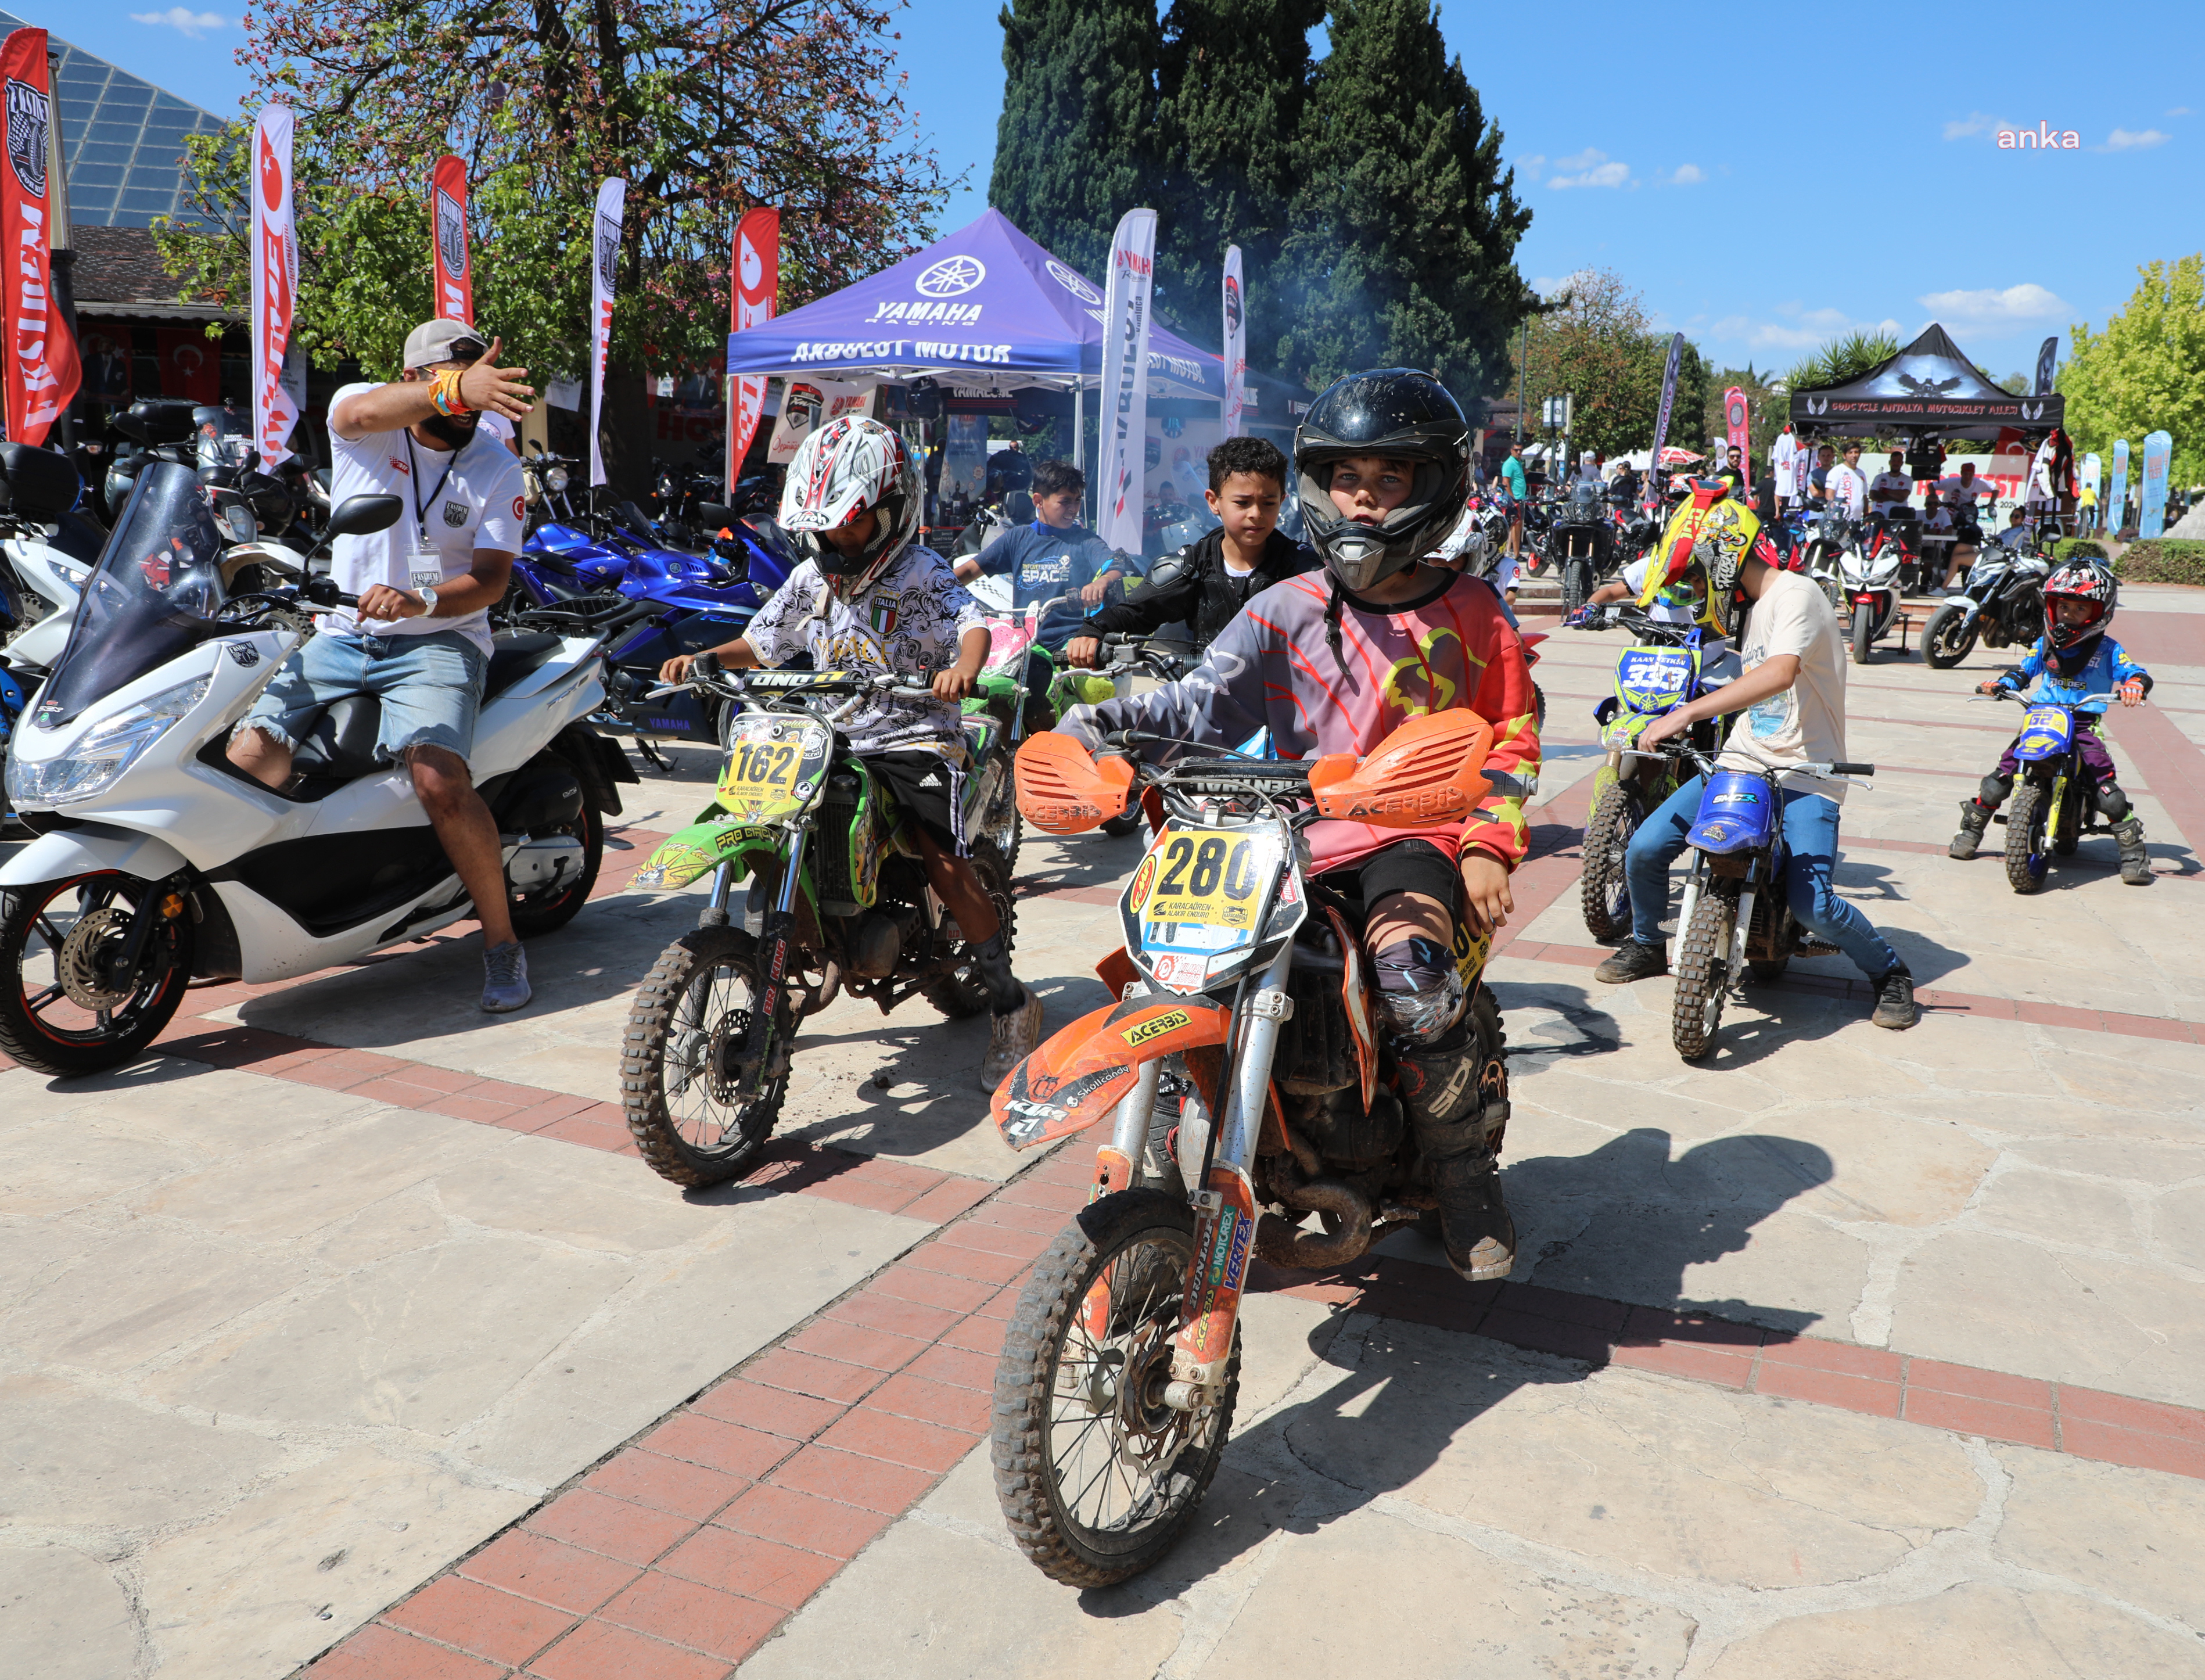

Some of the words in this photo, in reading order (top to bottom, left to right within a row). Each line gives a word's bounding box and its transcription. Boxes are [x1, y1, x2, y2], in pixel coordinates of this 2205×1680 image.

[874, 301, 983, 321] YAMAHA
[865, 318, 976, 326] RACING
[915, 342, 1012, 363] MOTOR
[1832, 402, 1879, 412] GODCYCLE
[1881, 403, 1924, 413] ANTALYA
[447, 502, 468, 515] EKSTREM
[787, 511, 828, 523] Airoh
[413, 572, 439, 581] EKSTREM
[1022, 569, 1070, 582] SPACE
[875, 597, 896, 609] ITALIA
[2088, 656, 2101, 668] 62
[1622, 663, 1689, 692] 333
[649, 718, 691, 730] YAMAHA
[2028, 714, 2054, 726] 62
[737, 744, 795, 785] 162
[716, 828, 744, 850] PRO
[1157, 837, 1258, 900] 280
[1134, 860, 1150, 909] FMF
[1169, 901, 1211, 911] KARACAÖREN
[1179, 962, 1205, 975] YILMAZ
[1459, 956, 1475, 978] ARACAÖREN
[1174, 973, 1201, 984] MOTOR
[1077, 1066, 1129, 1099] Skullcandy
[1213, 1208, 1234, 1266] MOTOREX
[1224, 1208, 1251, 1291] VERTEX
[1190, 1219, 1214, 1309] DUNLOP
